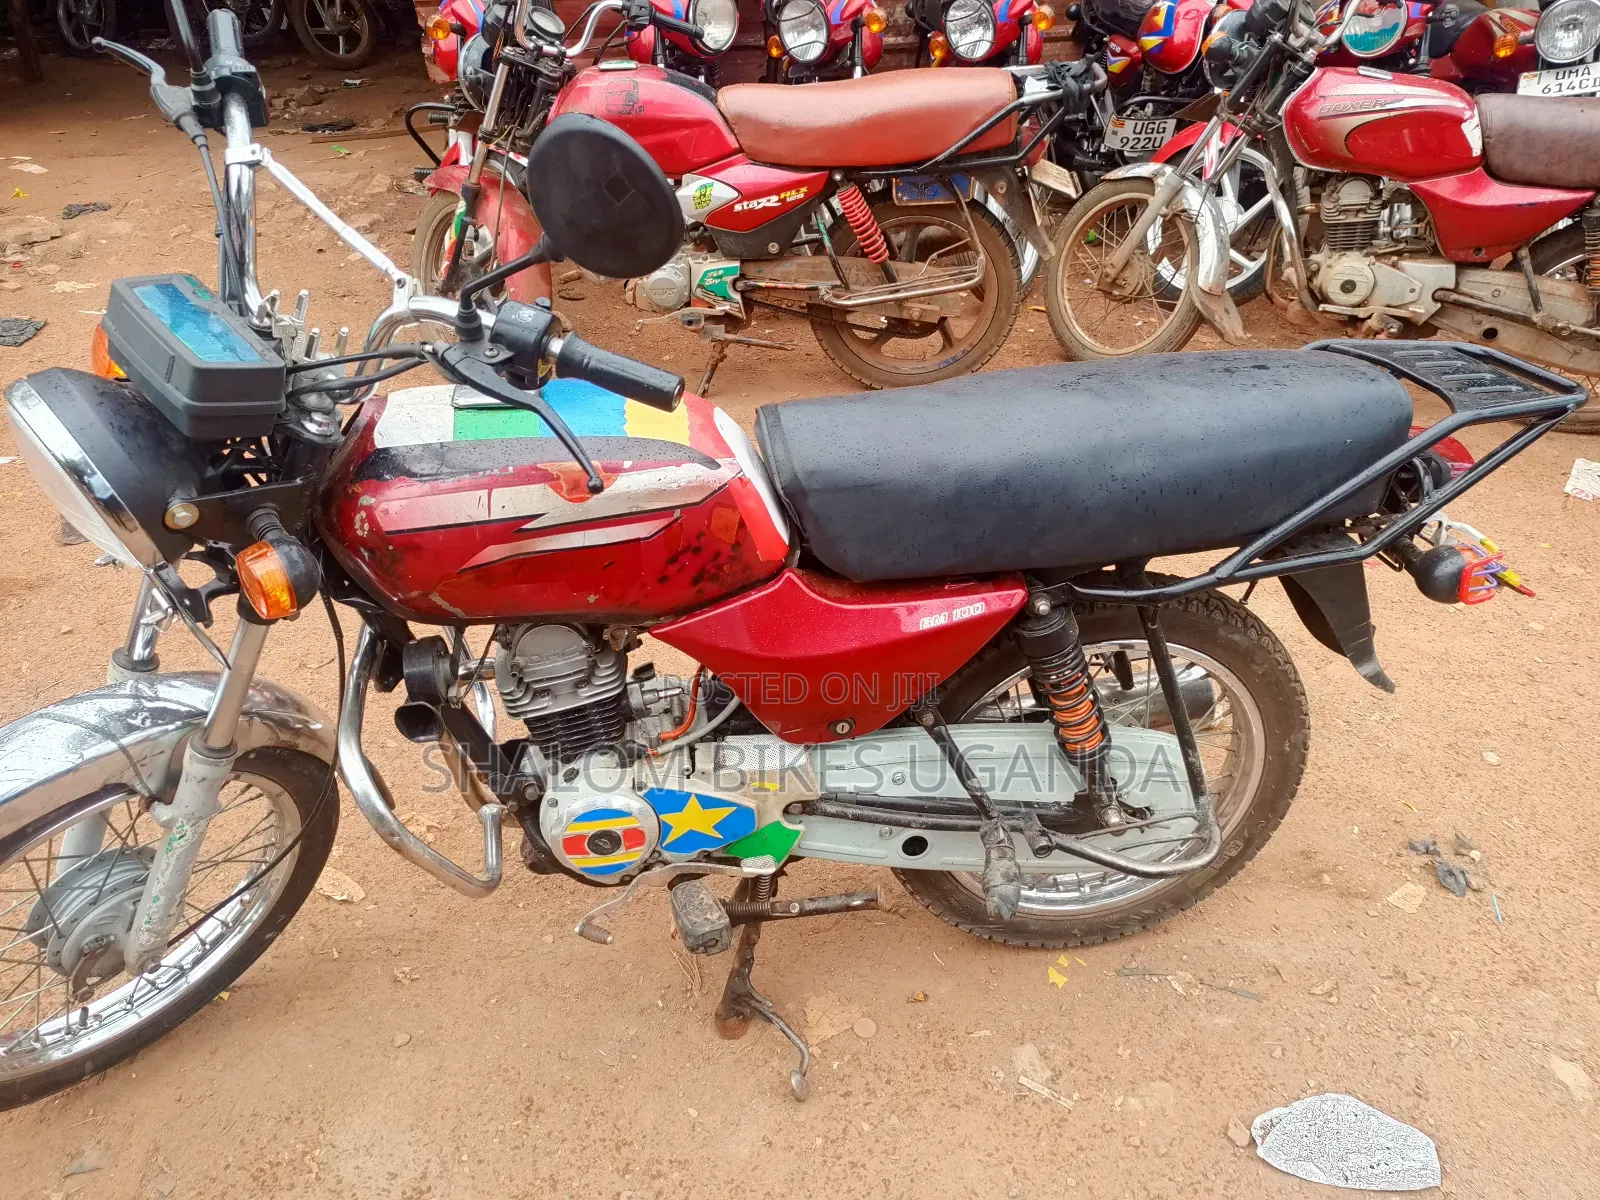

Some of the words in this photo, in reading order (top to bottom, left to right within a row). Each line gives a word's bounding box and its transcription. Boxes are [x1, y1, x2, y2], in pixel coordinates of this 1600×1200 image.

[1555, 66, 1592, 81] UMA
[1316, 98, 1388, 115] BOXER
[1132, 121, 1168, 136] UGG
[1120, 136, 1164, 150] 922U
[780, 186, 808, 200] HLX
[920, 612, 948, 629] BM
[952, 601, 986, 621] 100
